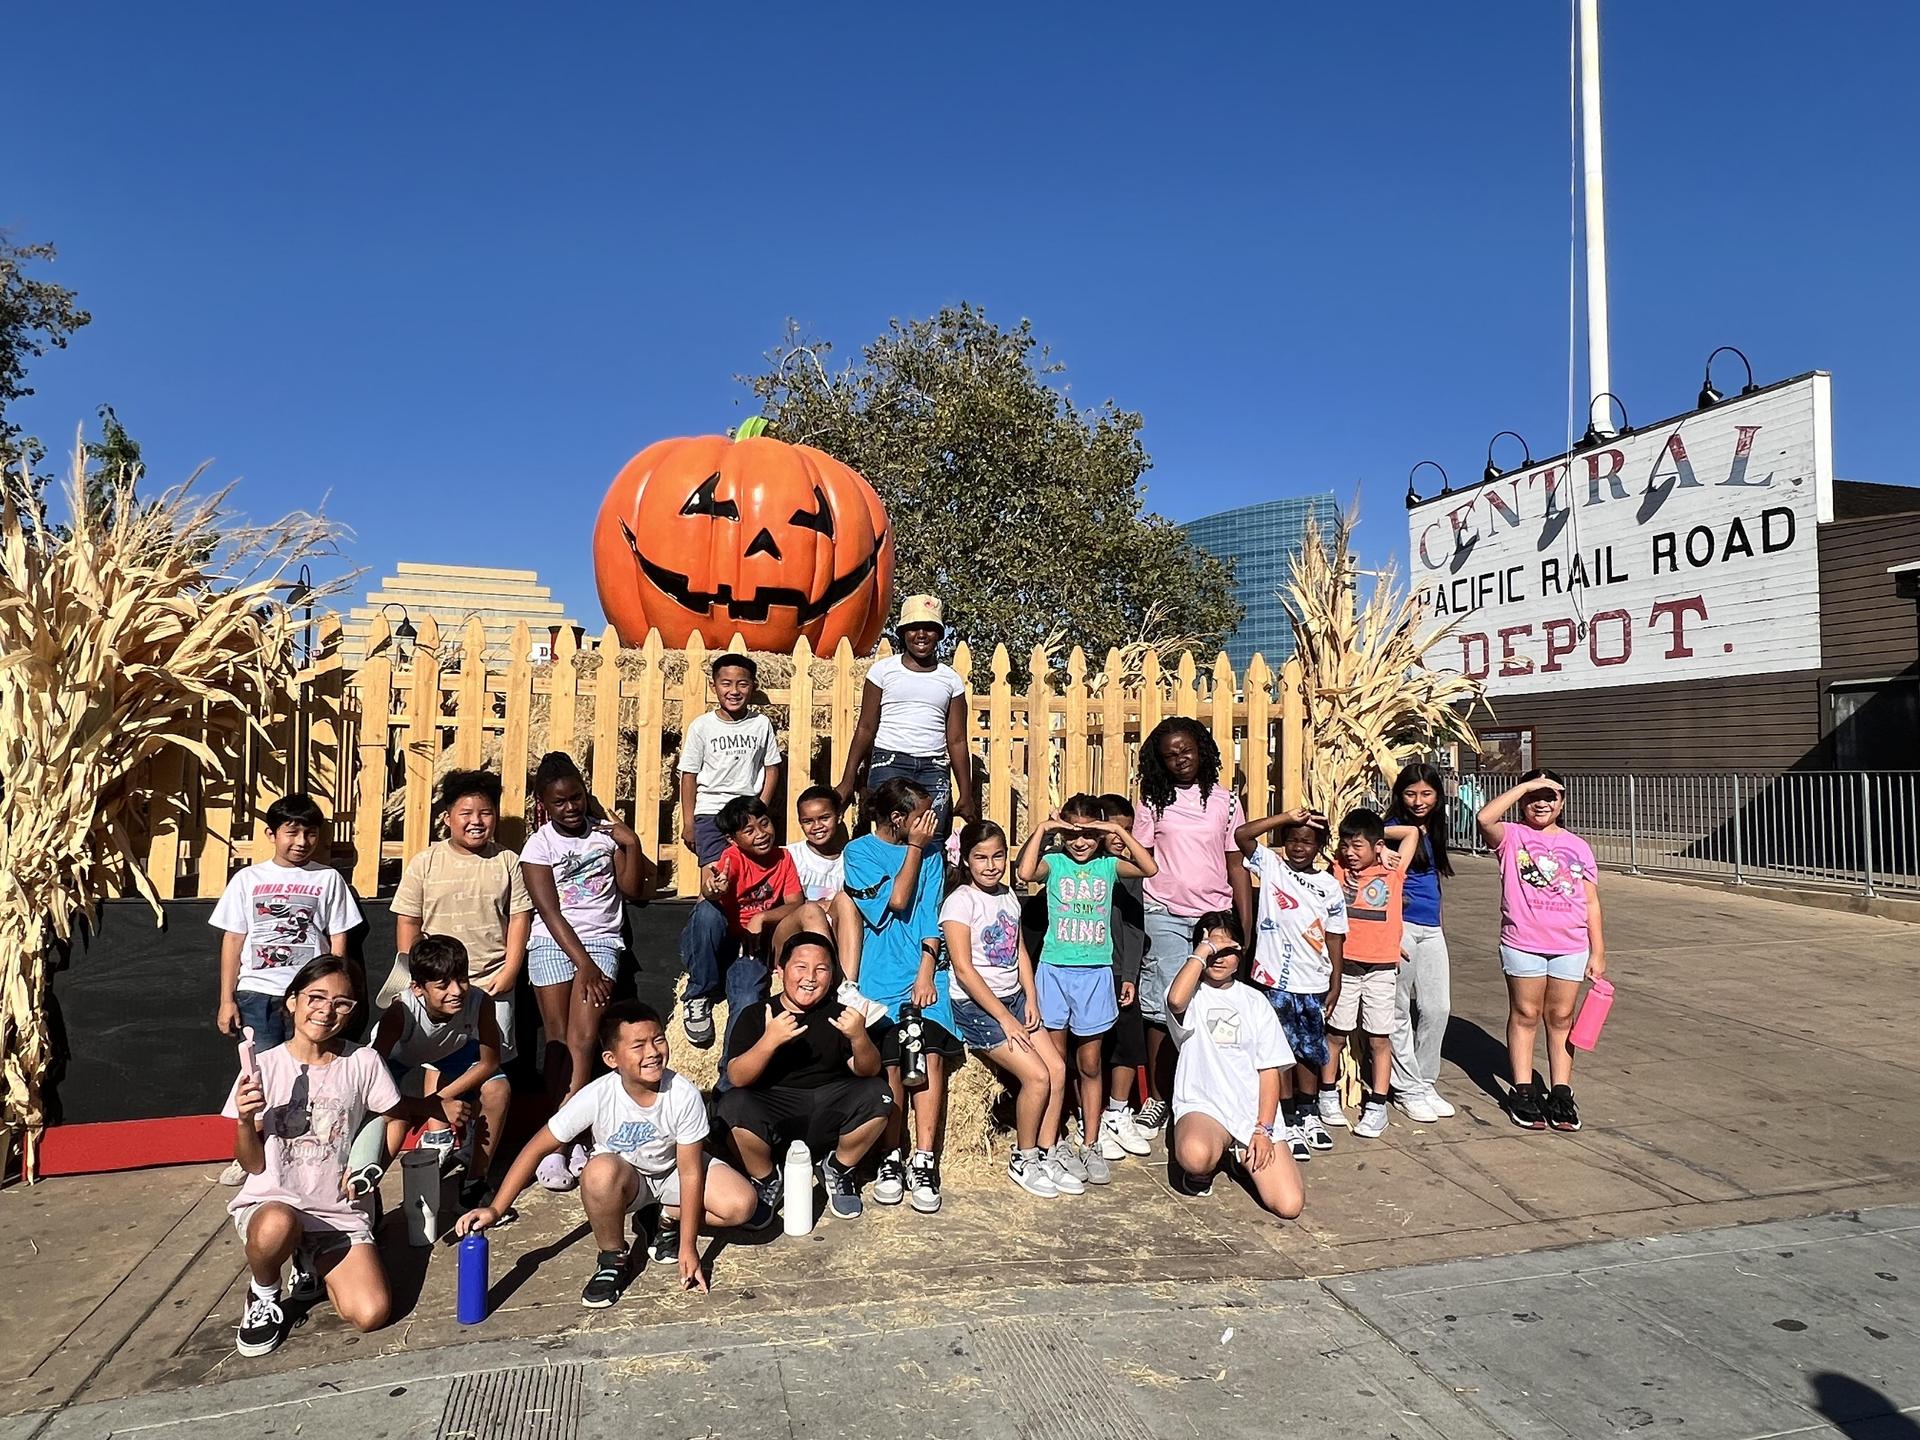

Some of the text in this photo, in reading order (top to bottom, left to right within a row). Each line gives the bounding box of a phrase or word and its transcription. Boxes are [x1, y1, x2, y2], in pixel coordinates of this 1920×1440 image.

[1419, 425, 1774, 571] CENTRAL
[1542, 545, 1629, 597] RAIL
[1652, 506, 1796, 575] ROAD
[711, 734, 758, 752] TOMMY
[252, 884, 322, 897] NINJA SKILLS
[1060, 877, 1107, 902] DAD
[1073, 903, 1081, 914] IS
[1057, 917, 1106, 946] KING
